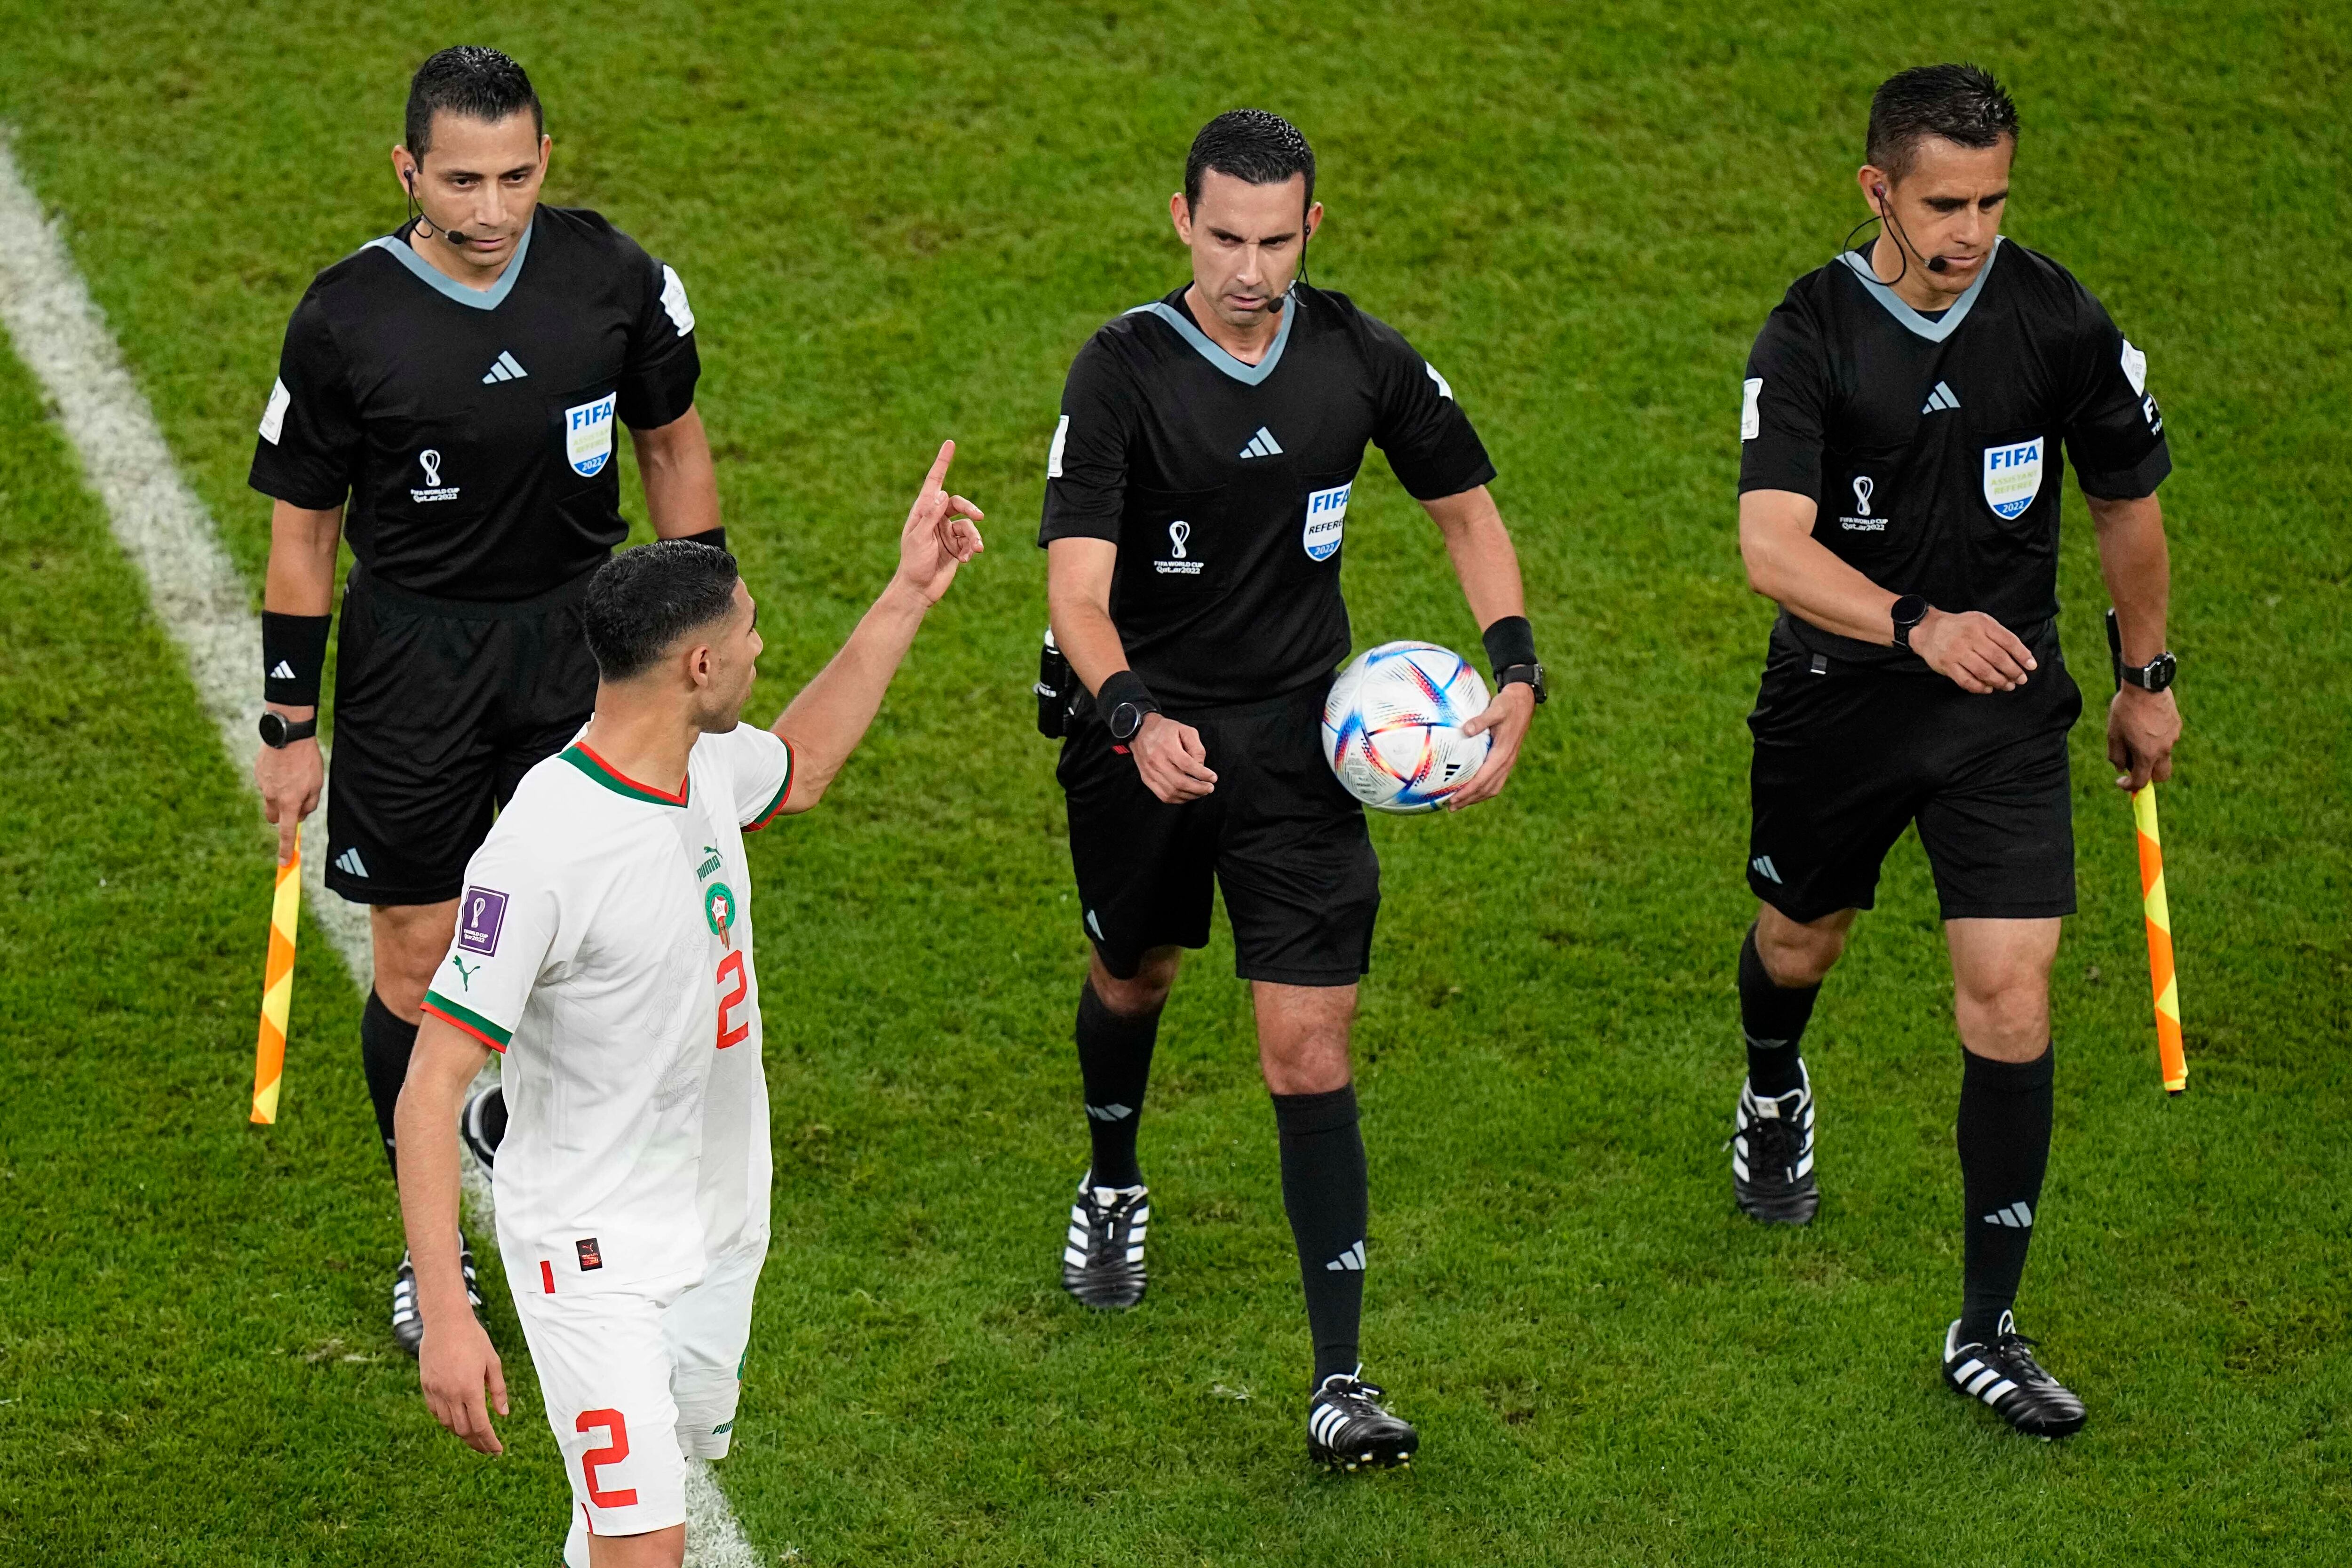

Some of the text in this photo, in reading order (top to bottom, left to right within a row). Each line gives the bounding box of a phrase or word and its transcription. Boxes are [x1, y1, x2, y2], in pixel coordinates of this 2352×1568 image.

[573, 401, 612, 430] FIFA
[581, 457, 603, 471] 2022
[1991, 446, 2038, 470] FIFA
[1991, 470, 2037, 486] ASSISTANT
[1994, 478, 2033, 494] REFEREE
[1313, 488, 1350, 513] FIFA
[2002, 500, 2025, 513] 2022
[1314, 542, 1335, 556] 2022
[697, 854, 721, 883] PUMA
[716, 949, 748, 1050] 2
[576, 1408, 638, 1508] 2
